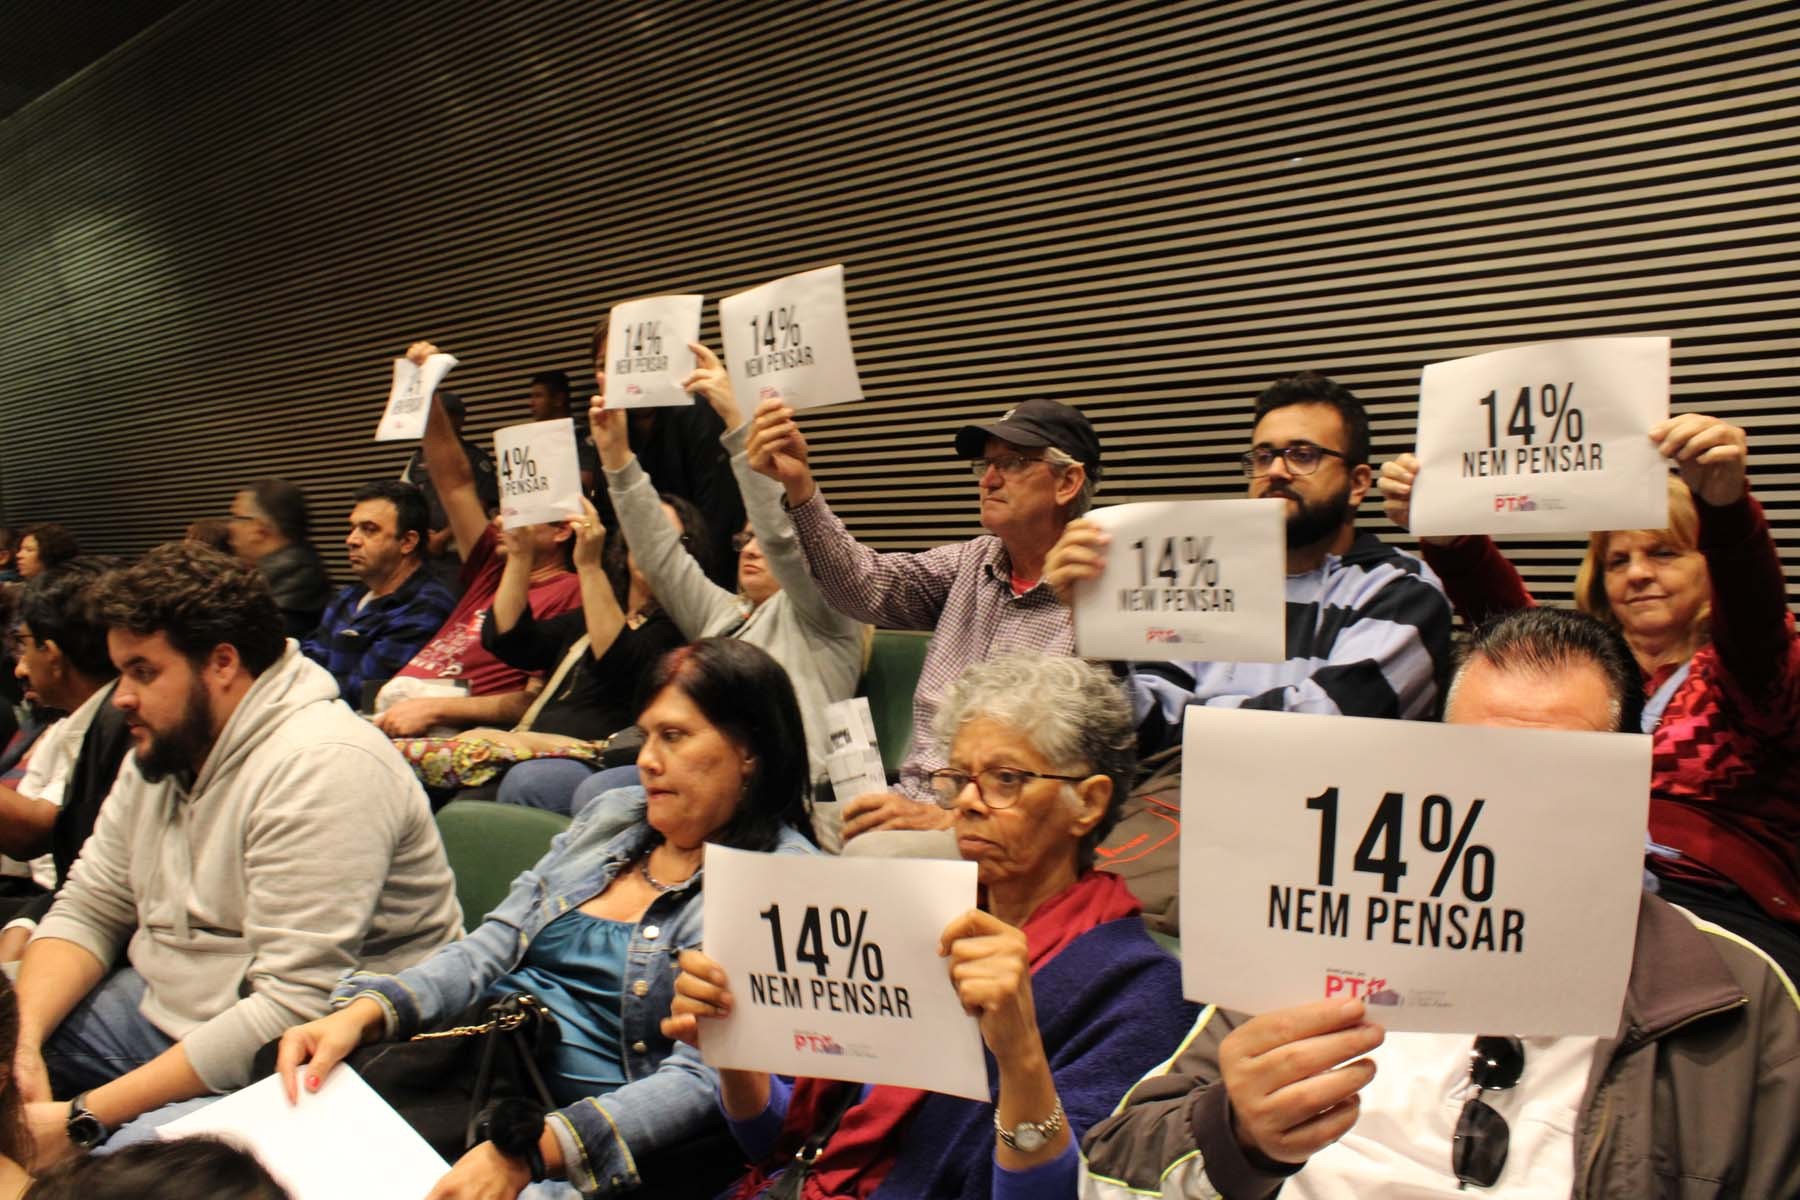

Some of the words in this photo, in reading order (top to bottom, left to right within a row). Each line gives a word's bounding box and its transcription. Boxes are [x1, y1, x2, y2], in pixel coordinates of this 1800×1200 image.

[624, 321, 662, 357] 14%
[749, 305, 801, 355] 14%
[1480, 382, 1583, 448] 14%
[1463, 449, 1507, 478] NEM
[1516, 443, 1603, 475] PENSAR
[505, 476, 550, 496] PENSAR
[1131, 536, 1219, 587] 14%
[1162, 588, 1235, 612] PENSAR
[1306, 787, 1496, 902] 14%
[760, 903, 884, 982] 14%
[1268, 885, 1350, 938] NEM
[1366, 896, 1526, 953] PENSAR
[750, 973, 803, 1009] NEM
[811, 979, 912, 1019] PENSAR
[1325, 975, 1365, 999] PT
